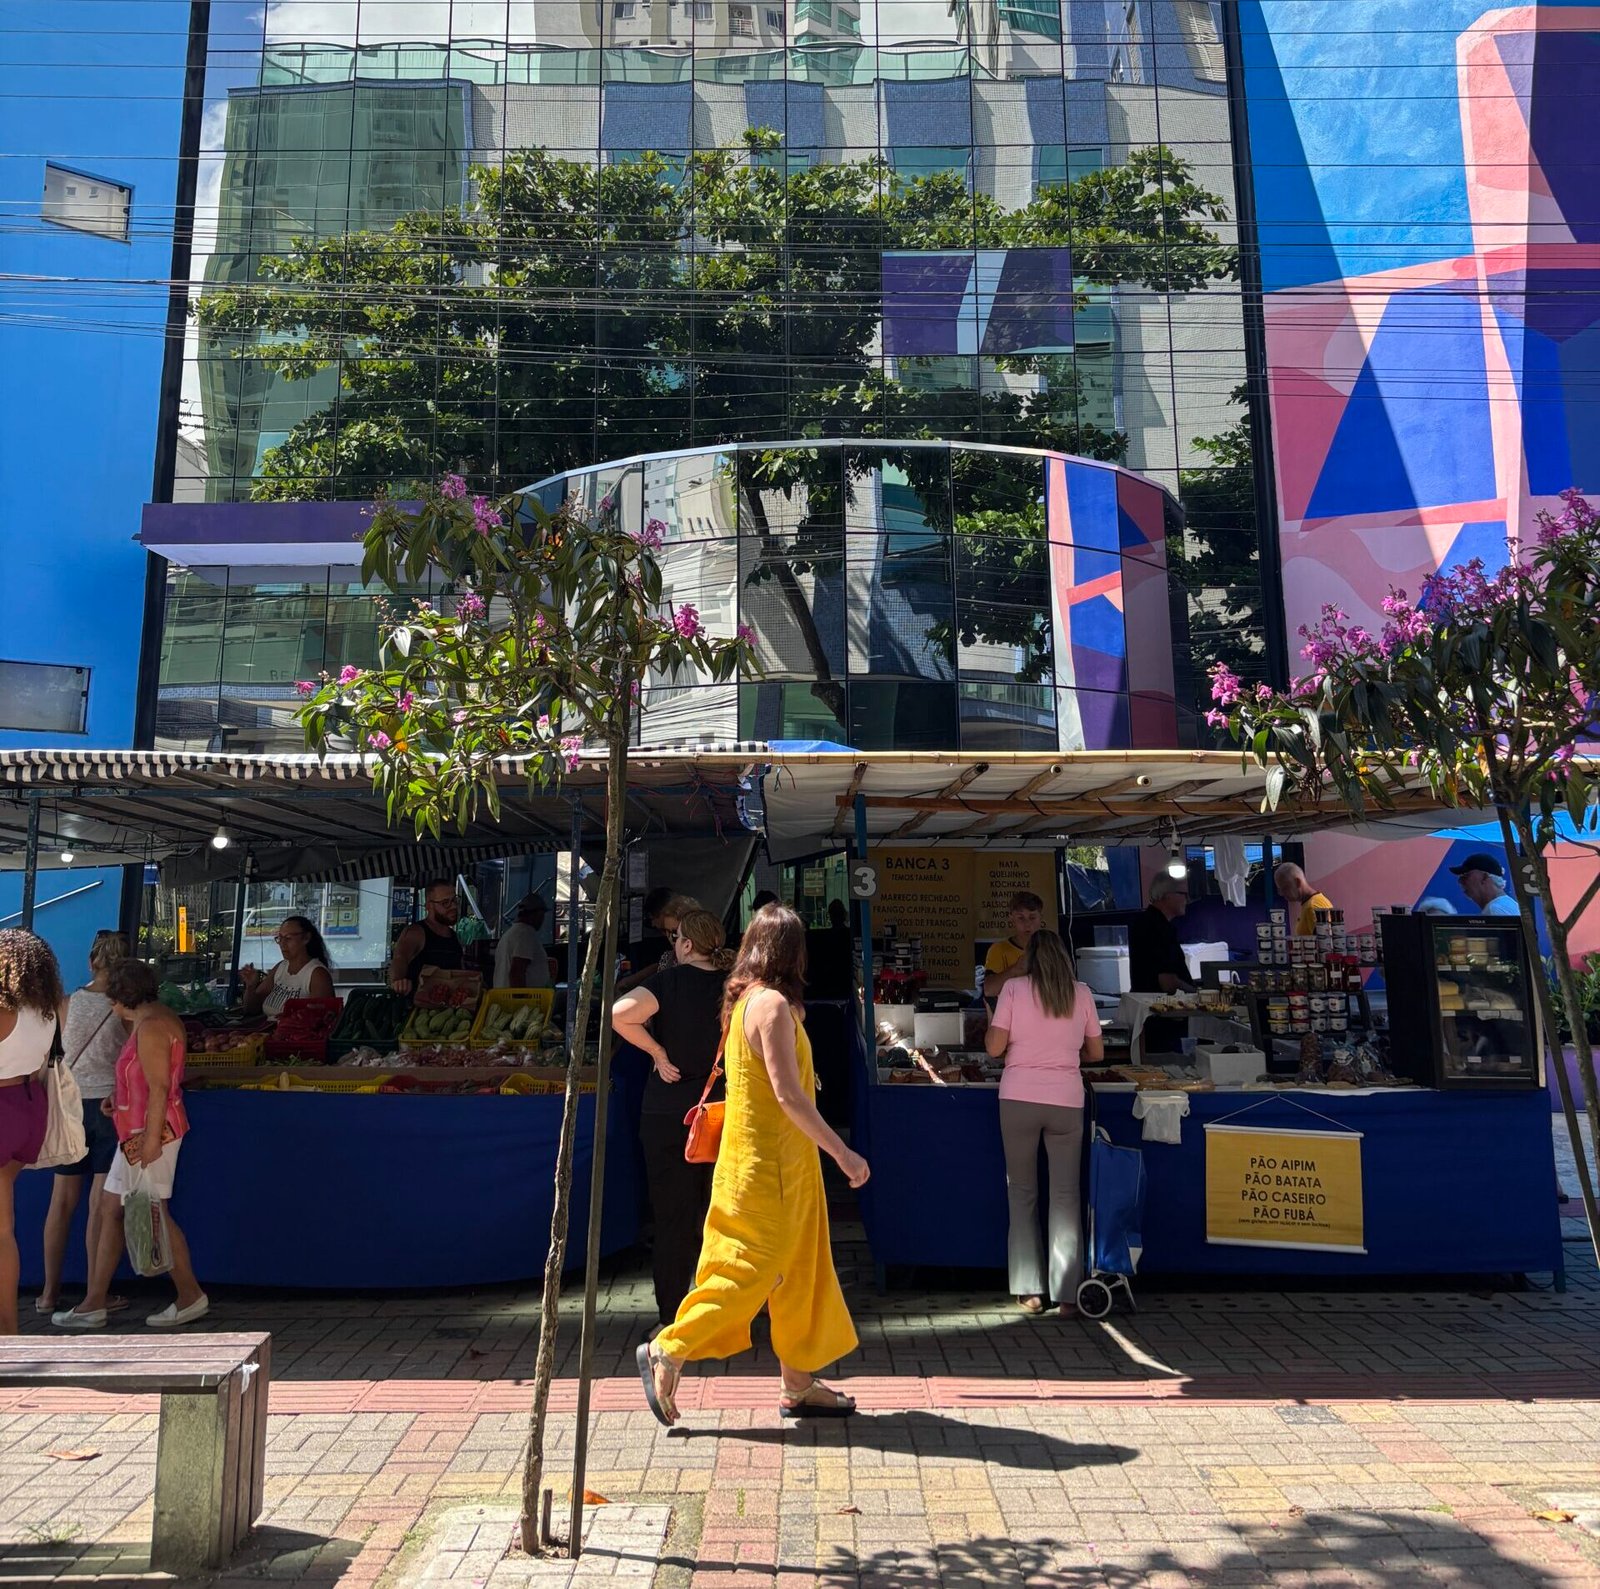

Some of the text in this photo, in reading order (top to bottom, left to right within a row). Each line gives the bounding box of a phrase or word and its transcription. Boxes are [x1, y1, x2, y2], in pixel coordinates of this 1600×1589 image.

[886, 857, 950, 870] BANCA 3
[853, 867, 877, 897] 3
[880, 894, 960, 902] MARRECO RECHEADO
[873, 905, 968, 915] FRANGO CAIPIRA PICADO
[926, 919, 958, 927] FRANGO
[979, 921, 1006, 929] QUEIJO
[937, 932, 965, 940] PICADA
[930, 945, 958, 953] PORCO
[928, 959, 960, 967] FRANGO
[1251, 1155, 1316, 1171] PÃO AIPIM
[1245, 1171, 1321, 1188] PÃO BATATA
[1241, 1188, 1326, 1205] PÃO CASEIRO
[1254, 1205, 1315, 1221] PÃO FUBÁ
